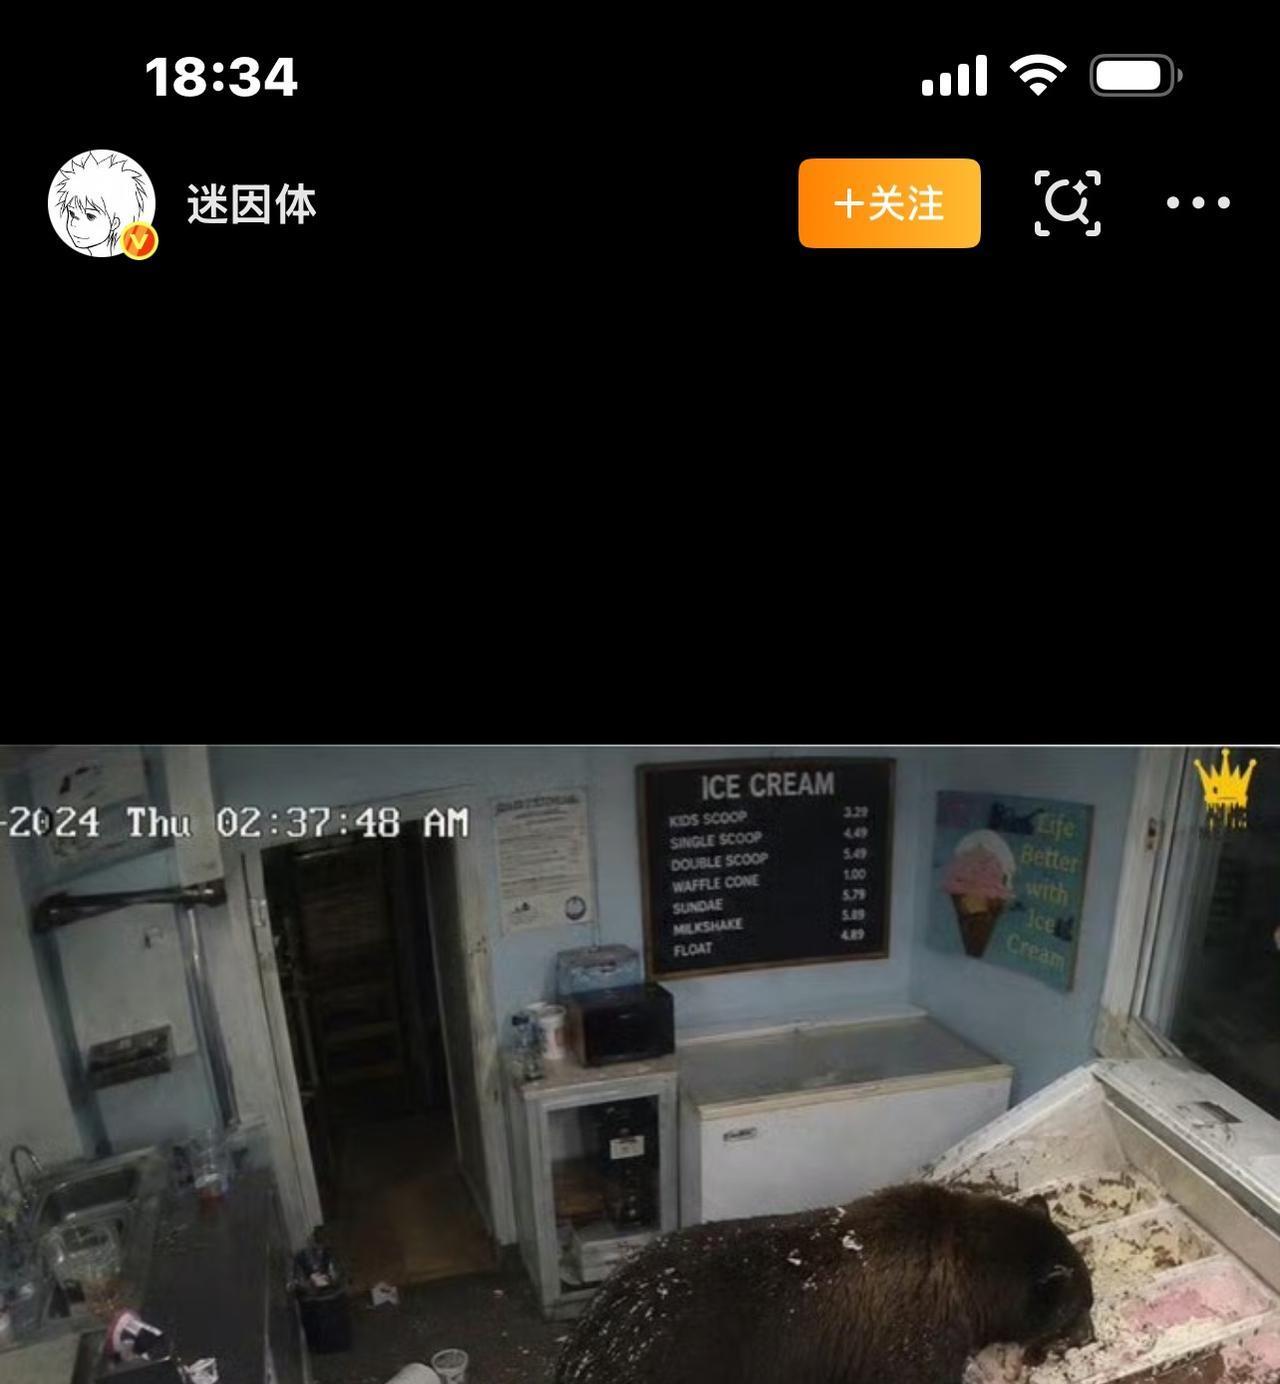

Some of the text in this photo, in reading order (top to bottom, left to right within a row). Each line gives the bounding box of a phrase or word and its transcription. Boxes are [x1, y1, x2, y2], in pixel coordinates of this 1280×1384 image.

[702, 771, 835, 800] ICE CREAM
[669, 814, 699, 828] KIDS
[703, 810, 748, 825] SCOOP
[670, 834, 715, 850] SINGLE
[719, 830, 763, 846] SCOOP
[671, 855, 722, 872] DOUBLE
[726, 851, 769, 867] SCOOP
[1022, 843, 1081, 874] Better
[672, 877, 721, 894] WAFFLE
[724, 873, 761, 889] CONE
[1025, 881, 1069, 907] with
[673, 898, 724, 916] SUNDAE
[673, 917, 744, 937] MILKSHAKE
[1028, 908, 1056, 933] Ice
[674, 941, 714, 958] FLOAT
[1006, 932, 1066, 970] Cream
